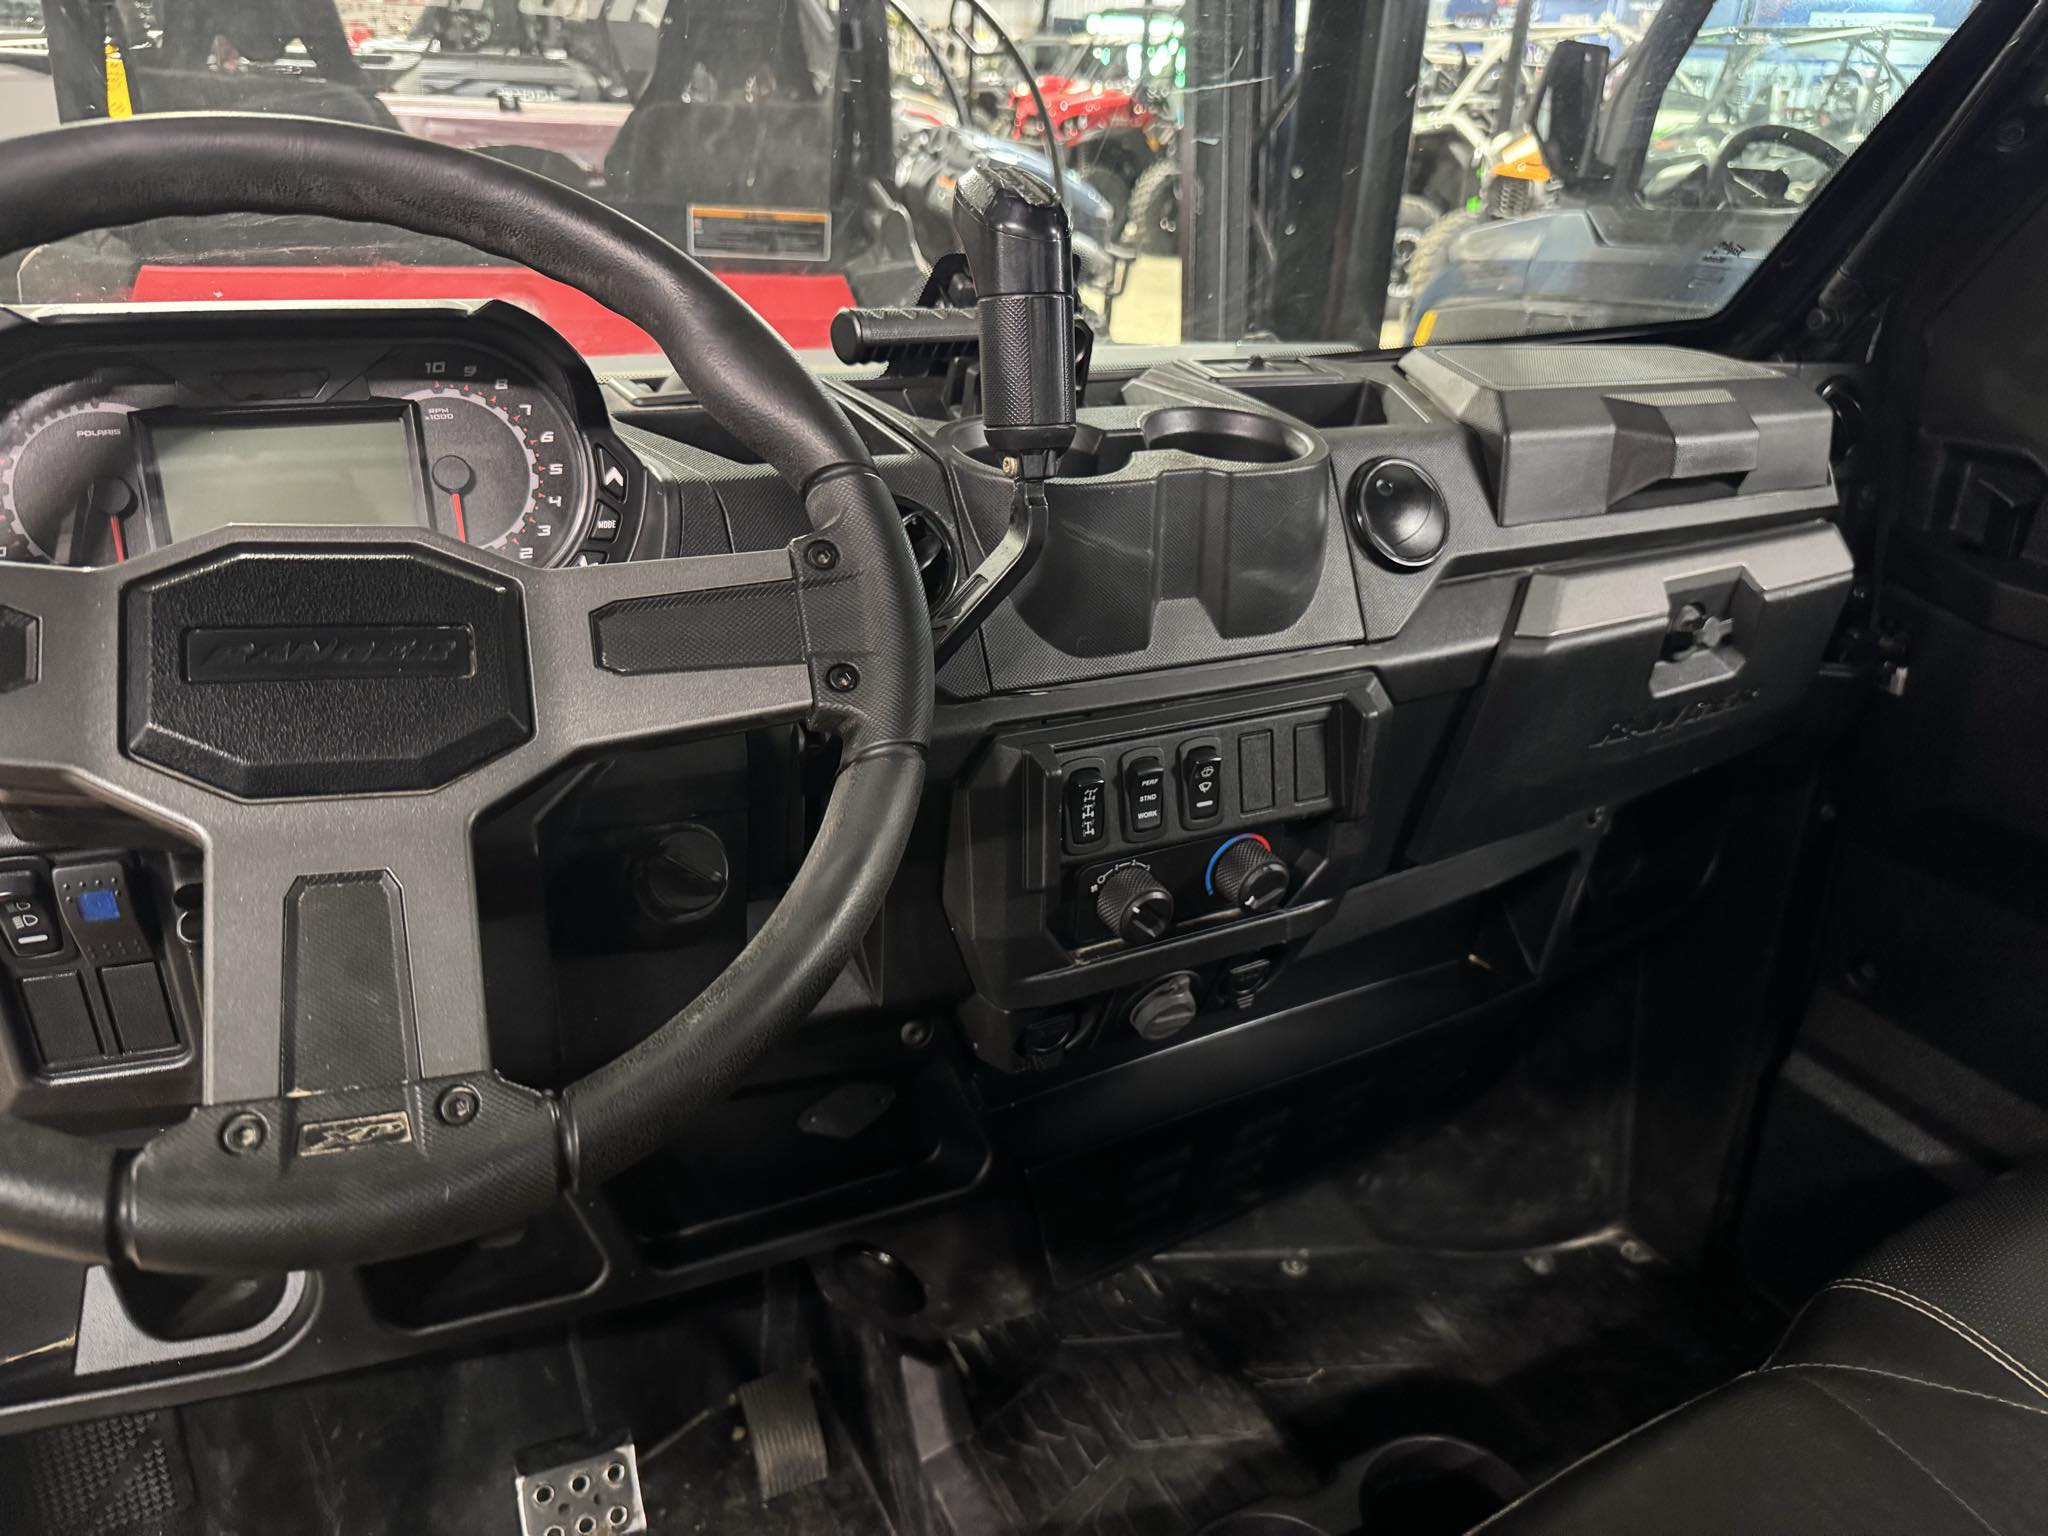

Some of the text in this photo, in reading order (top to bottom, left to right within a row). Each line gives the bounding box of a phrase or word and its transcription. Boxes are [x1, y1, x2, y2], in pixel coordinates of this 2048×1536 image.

[425, 361, 446, 374] 10
[463, 365, 477, 377] 9
[494, 379, 508, 390] 8
[519, 404, 532, 416] 7
[76, 428, 121, 438] POLARIS
[540, 431, 554, 443] 6
[550, 463, 563, 475] 5
[548, 496, 562, 507] 4
[598, 520, 617, 529] MODE
[537, 525, 551, 537] 3
[519, 547, 534, 559] 2
[1141, 778, 1159, 787] PERF
[1139, 793, 1157, 802] STND
[1137, 809, 1158, 819] WORK
